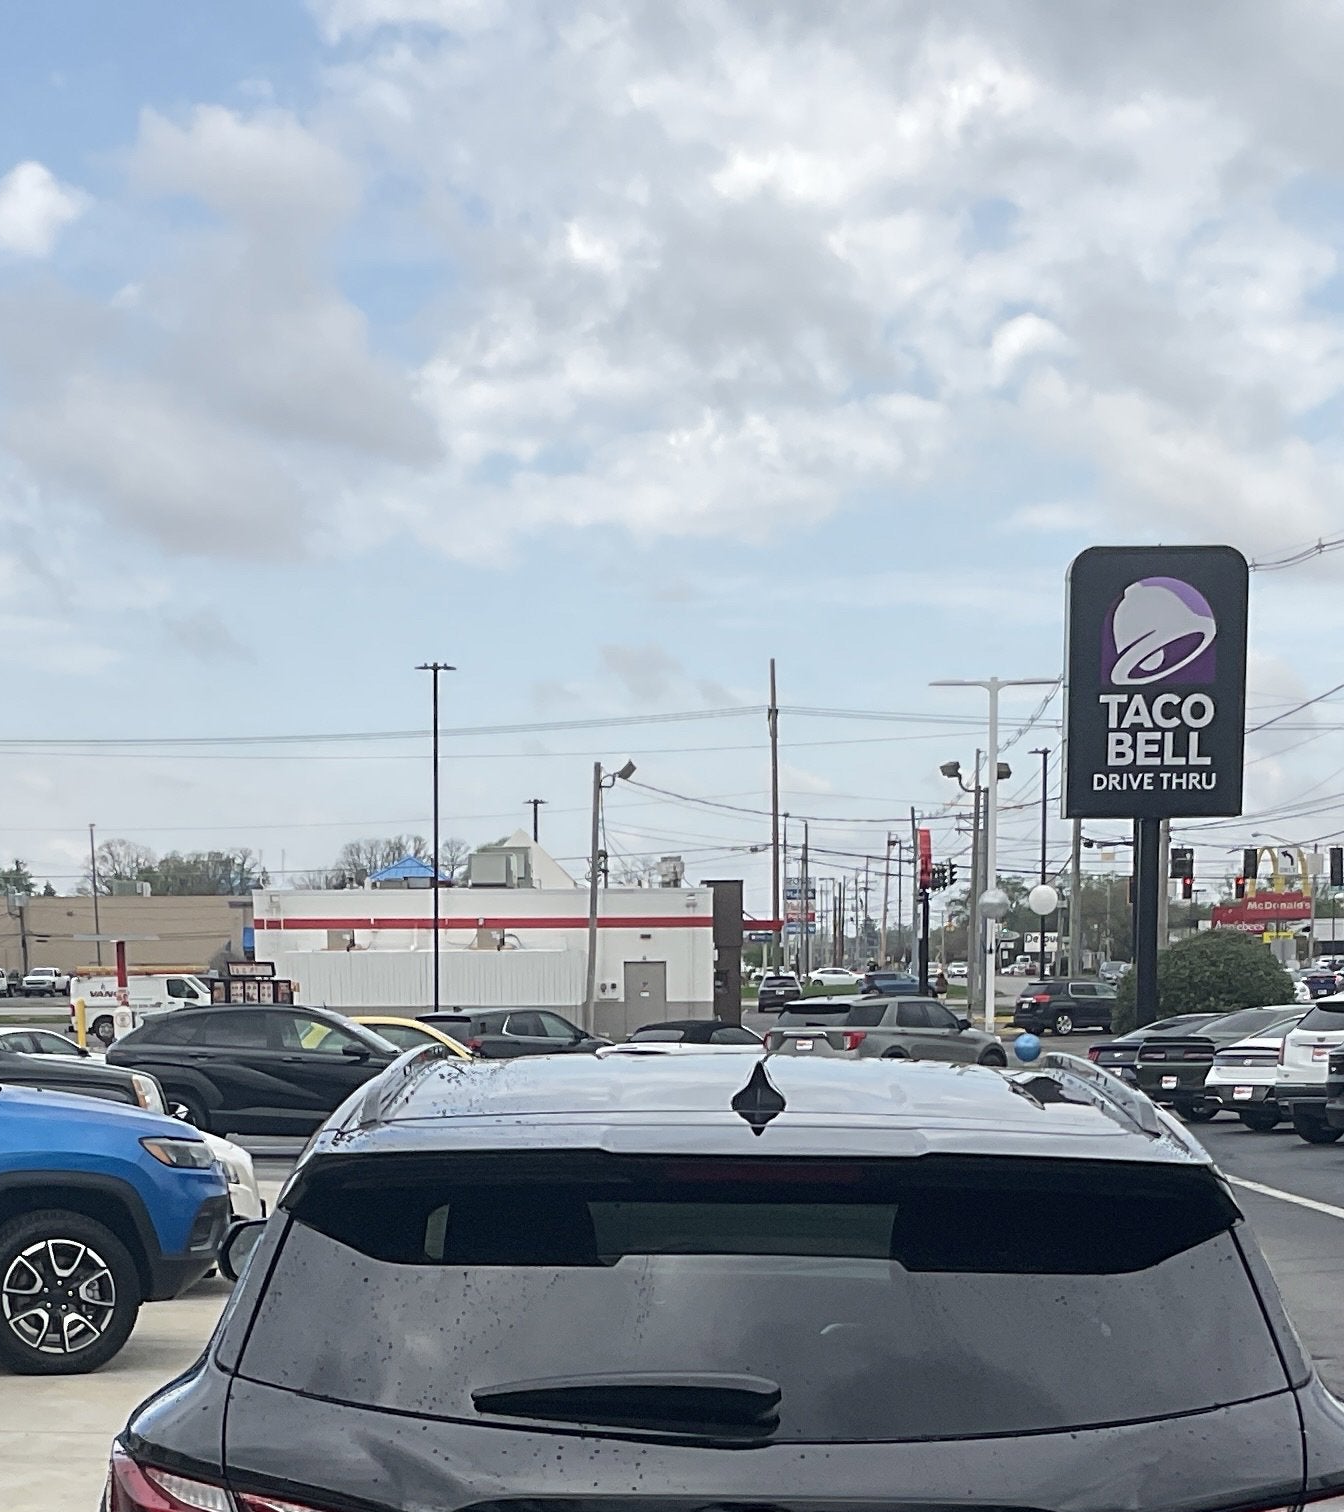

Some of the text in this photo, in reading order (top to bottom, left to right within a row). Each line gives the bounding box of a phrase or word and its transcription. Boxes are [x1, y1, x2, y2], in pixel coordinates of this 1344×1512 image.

[1099, 693, 1216, 729] TACO
[1107, 732, 1212, 766] BELL
[1093, 772, 1217, 791] DRIVE THRU
[1247, 902, 1311, 910] McDonald's
